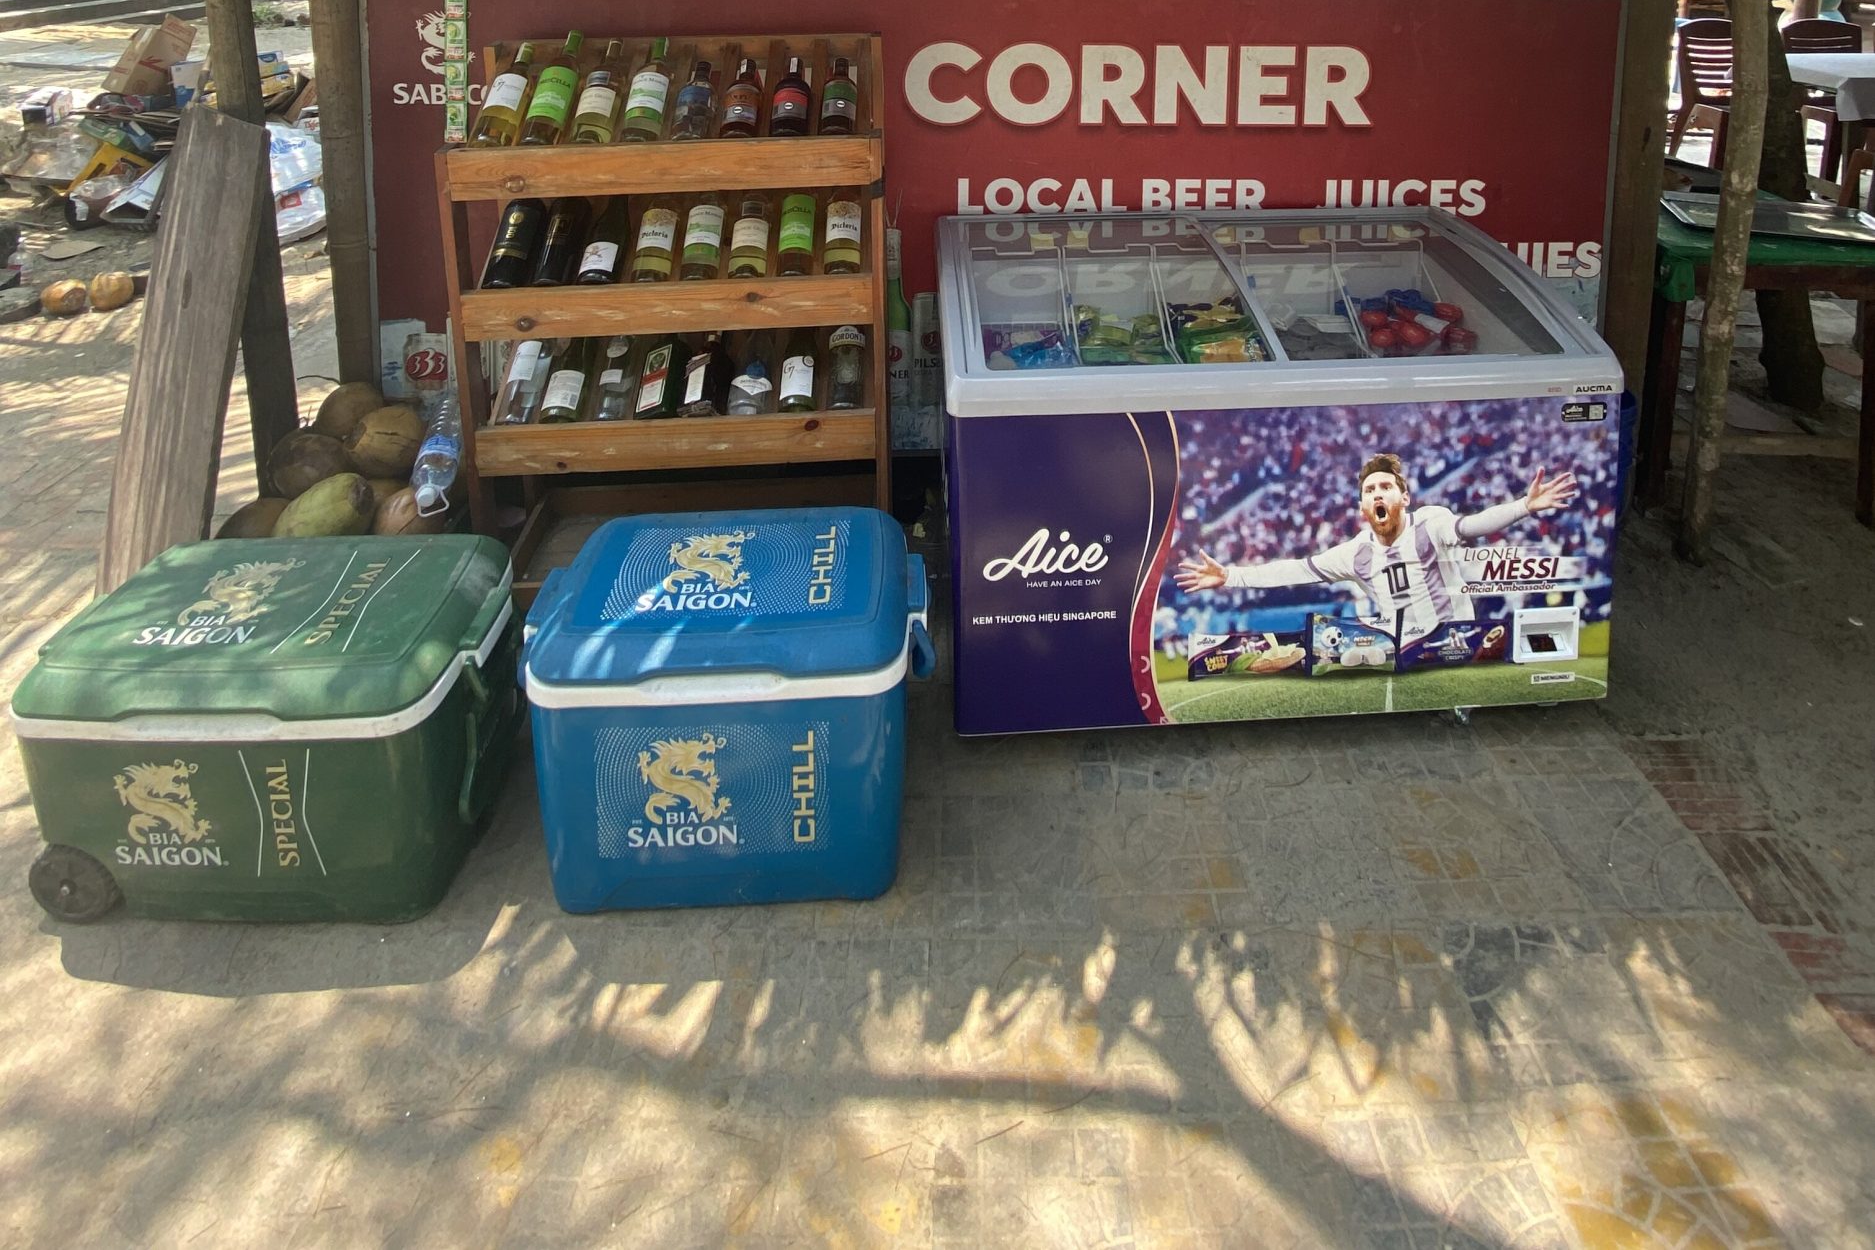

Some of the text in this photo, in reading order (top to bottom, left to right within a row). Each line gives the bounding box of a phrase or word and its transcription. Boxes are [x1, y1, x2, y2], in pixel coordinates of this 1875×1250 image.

[393, 83, 488, 105] SABC
[905, 43, 1371, 126] CORNER
[958, 178, 1486, 216] LOCAL BEER JUICES
[410, 349, 446, 378] 333
[1576, 384, 1613, 393] AUCMA
[808, 526, 837, 605] CHILL
[983, 528, 1109, 581] Aice
[1464, 547, 1520, 562] LIONEL
[1382, 562, 1410, 595] 10
[1482, 558, 1559, 581] MESSI
[681, 583, 715, 594] BIA
[1461, 582, 1556, 594] Official Ambassador
[304, 557, 391, 644] SPECIAL
[635, 591, 752, 612] SAIGON
[189, 615, 226, 626] BIA
[972, 616, 993, 625] KEM
[995, 614, 1036, 624] THƯƠNG
[1062, 610, 1117, 621] SINGAPORE
[132, 626, 256, 645] SAIGON
[791, 730, 816, 843] CHILL
[265, 758, 300, 867] SPECIAL
[665, 811, 699, 825] BIA
[149, 832, 182, 845] BIA
[627, 824, 738, 847] SAIGON
[115, 845, 222, 866] SAIGON
